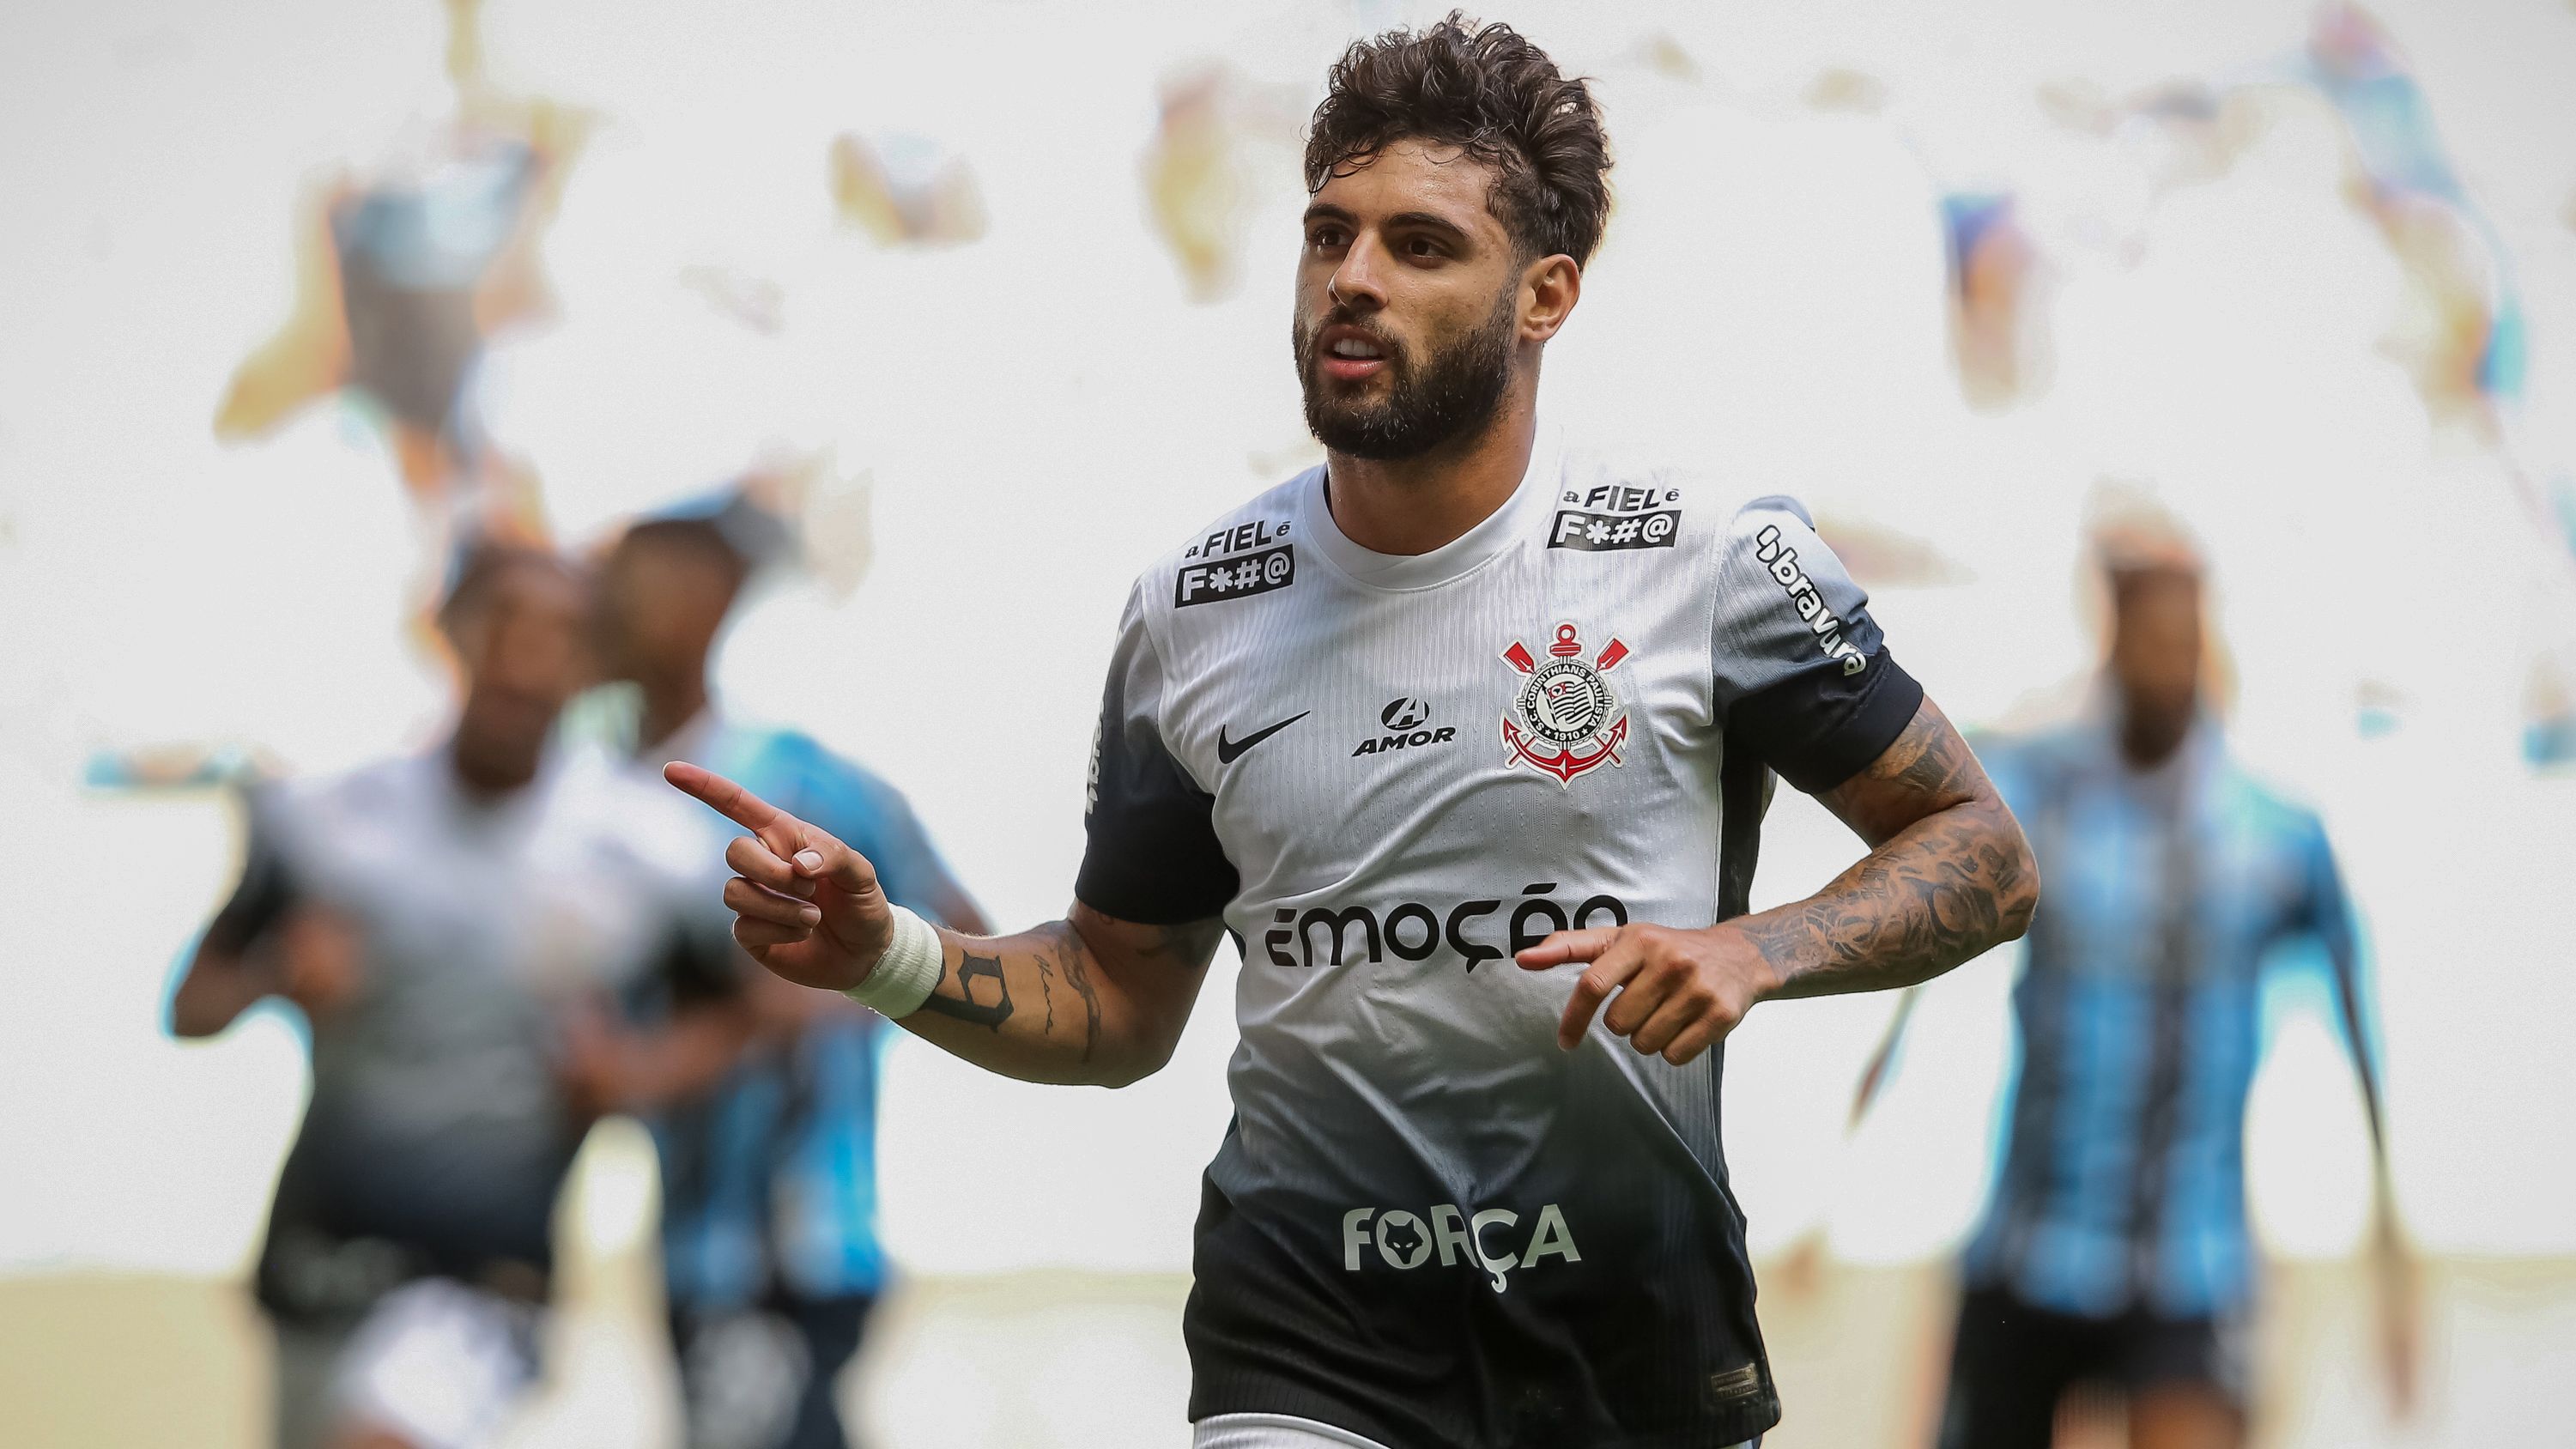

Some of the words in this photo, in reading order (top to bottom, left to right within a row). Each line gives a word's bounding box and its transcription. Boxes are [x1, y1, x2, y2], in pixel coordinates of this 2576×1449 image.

[1563, 490, 1579, 503] a
[1584, 485, 1661, 512] FIEL
[1185, 545, 1199, 559] a
[1202, 519, 1272, 558] FIEL
[1768, 547, 1867, 676] bravura
[1526, 664, 1587, 709] CORINTHIANS
[1586, 675, 1604, 728] PAULISTA
[1352, 727, 1457, 757] AMOR
[1554, 731, 1580, 741] 1910
[1343, 1203, 1582, 1294] FORÇA
